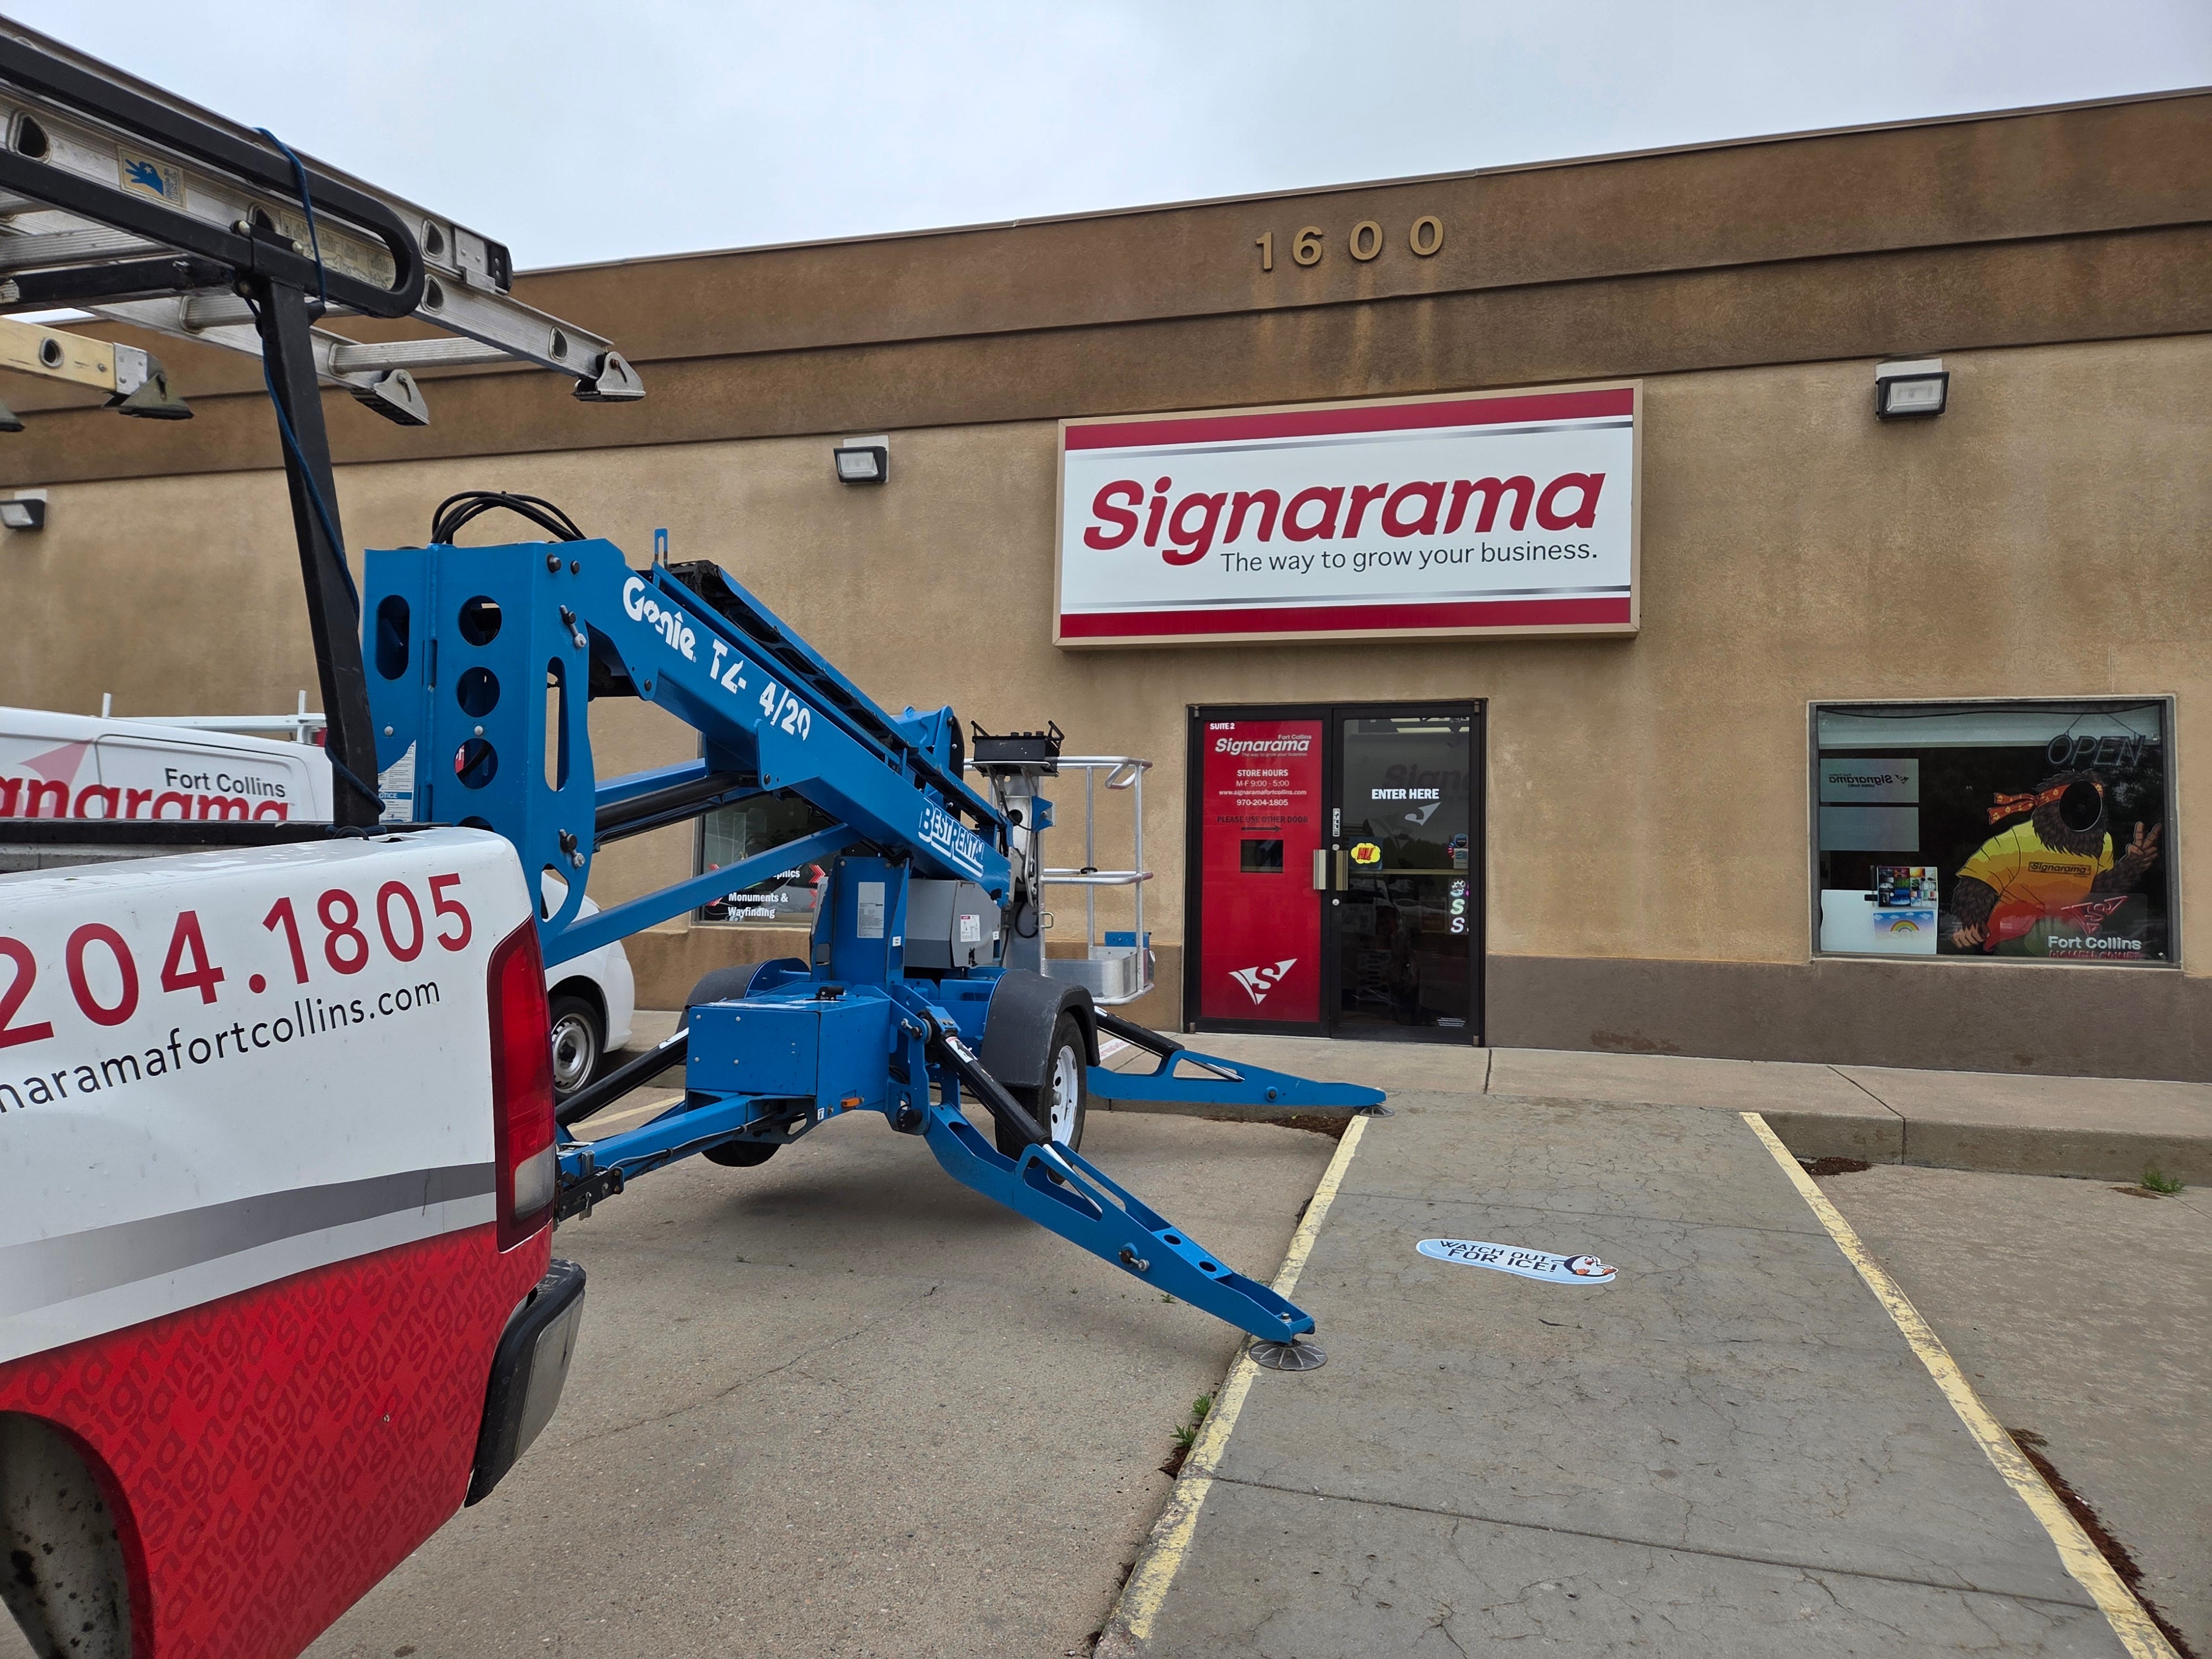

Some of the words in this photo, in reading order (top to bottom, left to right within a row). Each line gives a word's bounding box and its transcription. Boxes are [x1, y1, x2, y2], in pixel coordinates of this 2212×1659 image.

[1255, 215, 1443, 270] 1600
[1084, 472, 1605, 566] Signarama
[1220, 552, 1262, 572] The
[1269, 554, 1315, 574] way
[1322, 551, 1346, 568] to
[1353, 550, 1412, 572] grow
[1419, 549, 1475, 570] your
[1481, 540, 1597, 562] business.
[1215, 738, 1310, 755] Signarama
[2047, 734, 2146, 766] OPEN
[165, 768, 211, 791] Fort
[216, 773, 286, 797] Collins
[1371, 789, 1407, 800] ENTER
[1409, 789, 1439, 799] HERE
[1357, 847, 1374, 860] HI!
[2032, 862, 2086, 873] Signarama
[728, 892, 779, 902] Monuments
[780, 893, 789, 902] &
[728, 906, 775, 919] Wayfinding
[2048, 936, 2081, 948] Fort
[2085, 937, 2142, 950] Collins
[0, 873, 472, 1048] 204.1805
[1440, 1240, 1505, 1256] WATCH
[1511, 1252, 1548, 1262] OUT
[1448, 1249, 1499, 1263] FOR
[1507, 1258, 1557, 1272] ICE!
